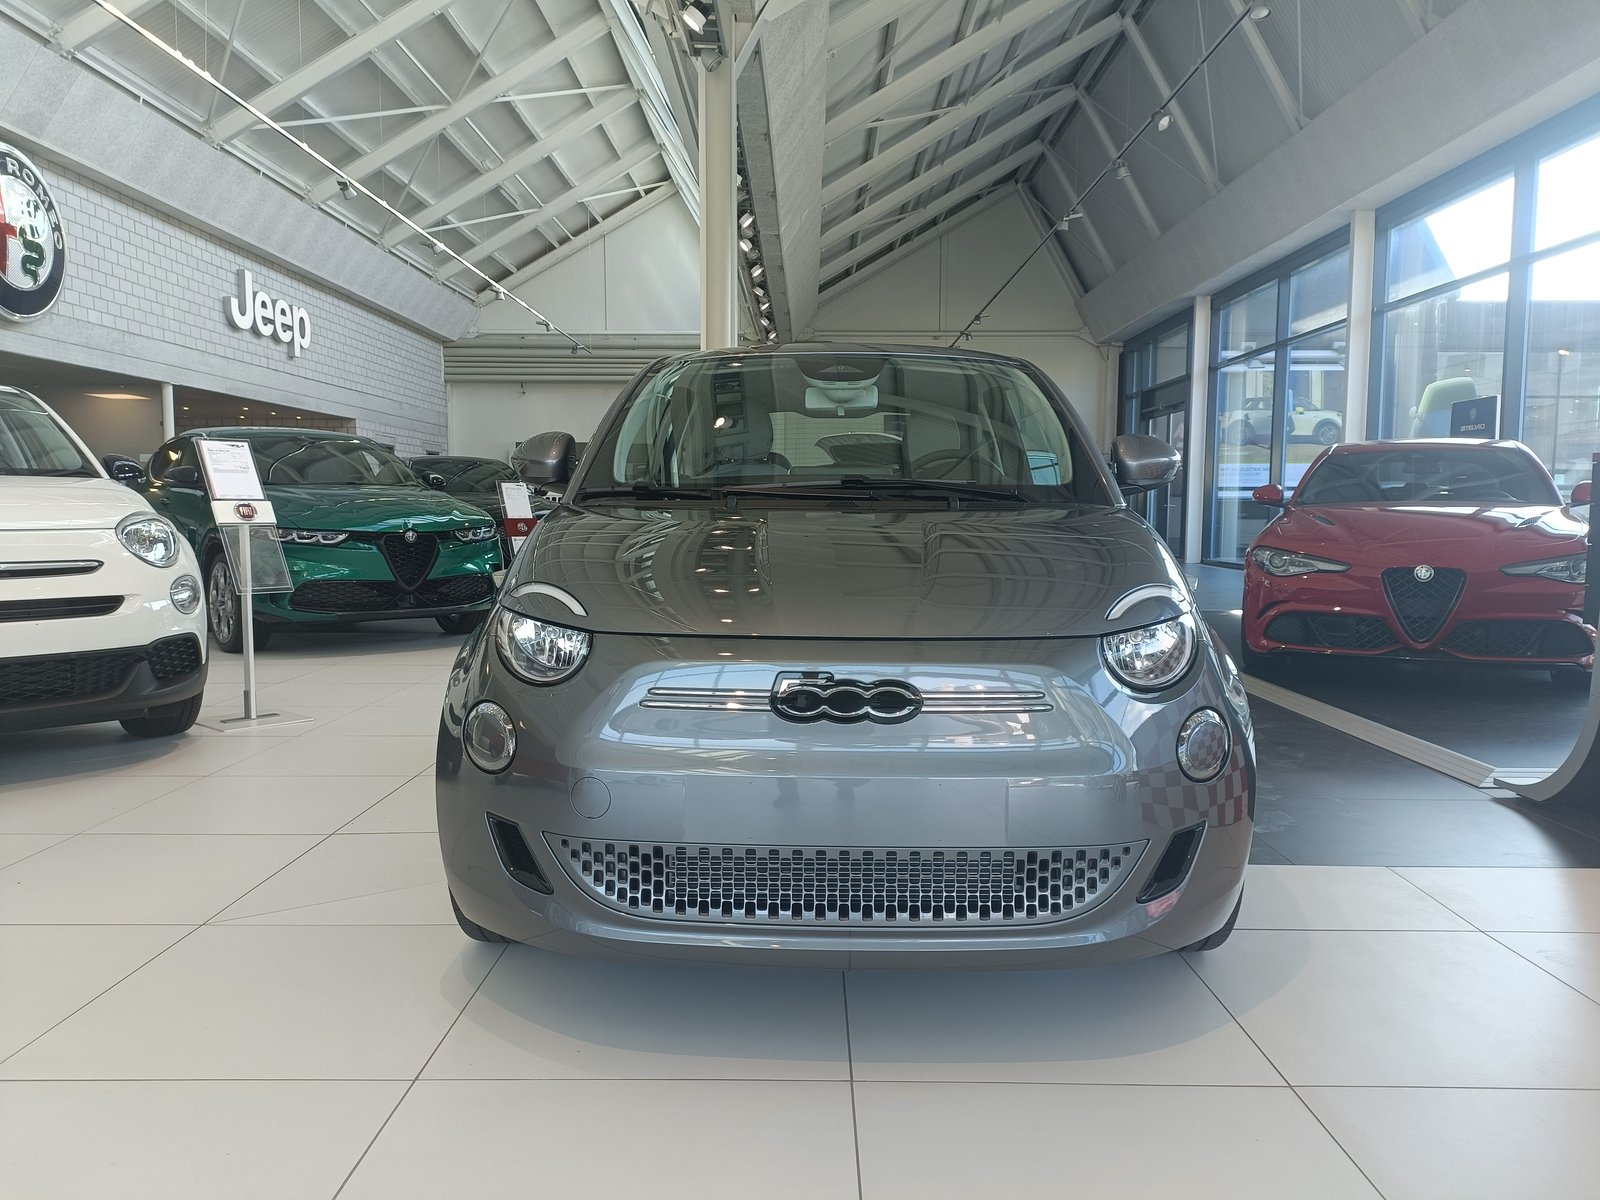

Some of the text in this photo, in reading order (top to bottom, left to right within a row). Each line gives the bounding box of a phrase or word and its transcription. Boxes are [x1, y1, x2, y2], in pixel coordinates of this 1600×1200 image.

[6, 156, 63, 250] ROMEO
[223, 268, 312, 358] Jeep
[1460, 423, 1486, 432] STELVIO
[769, 671, 924, 725] 500
